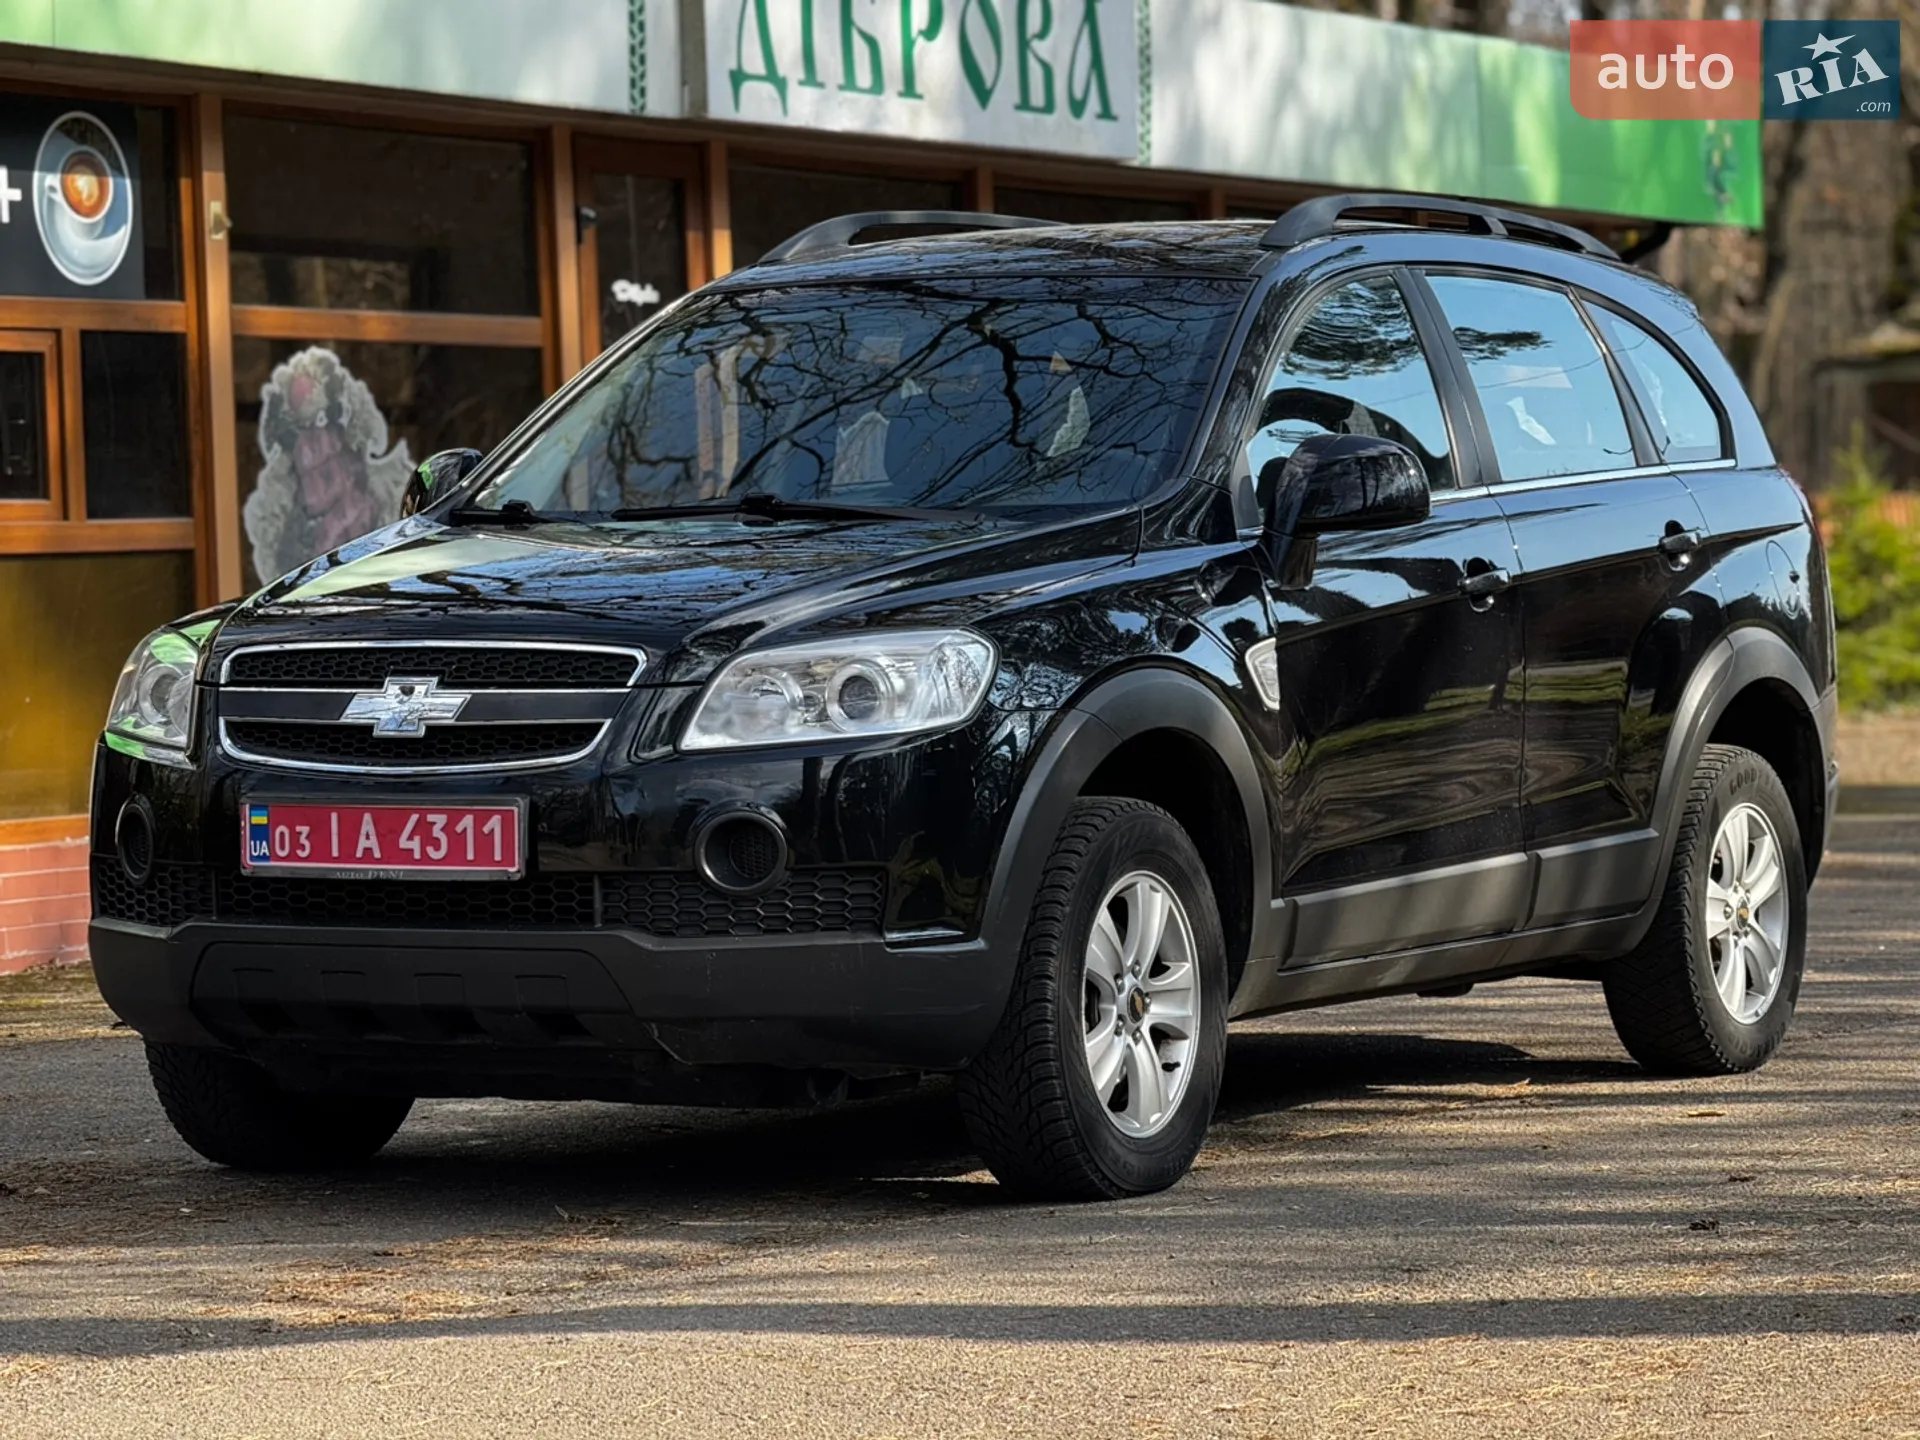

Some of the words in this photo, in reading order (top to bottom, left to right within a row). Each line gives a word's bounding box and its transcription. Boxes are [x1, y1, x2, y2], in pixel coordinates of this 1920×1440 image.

[250, 840, 270, 856] UA
[274, 825, 311, 858] 03
[398, 813, 502, 861] 4311
